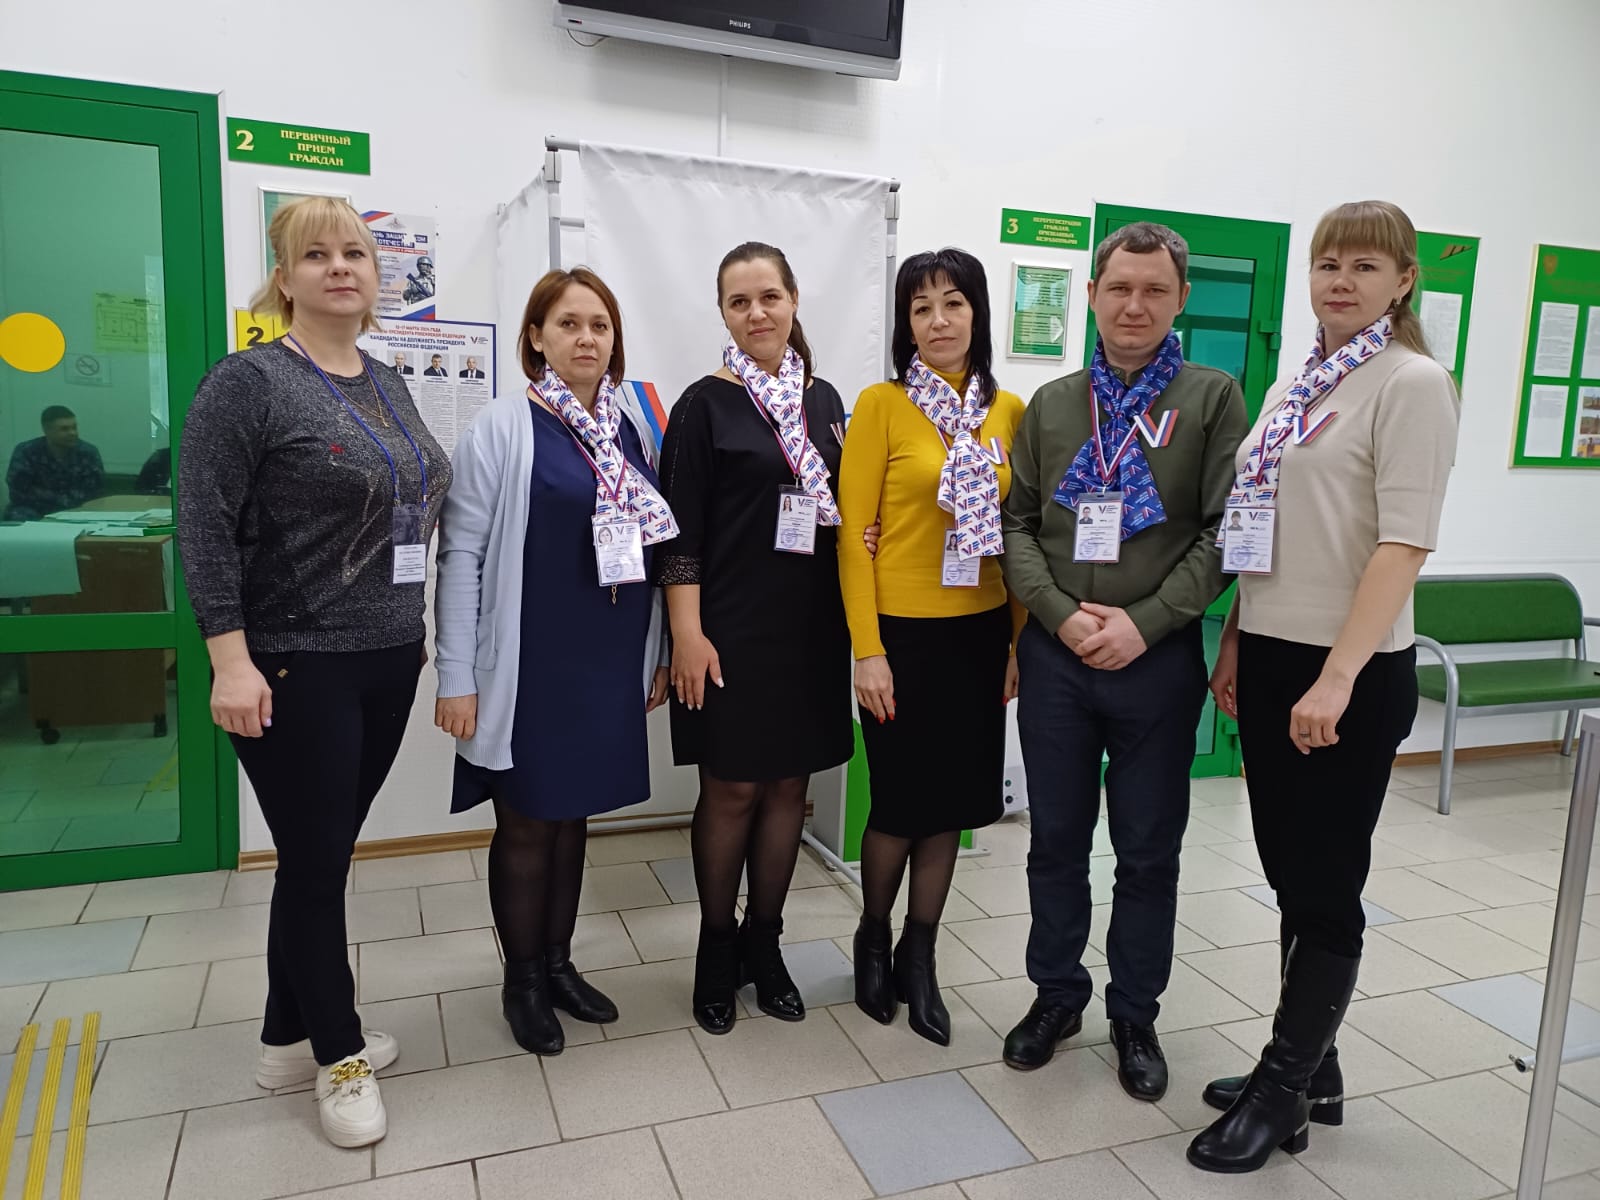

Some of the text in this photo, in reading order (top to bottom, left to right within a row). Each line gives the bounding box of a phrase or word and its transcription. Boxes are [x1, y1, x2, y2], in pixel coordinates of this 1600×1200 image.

[729, 19, 751, 29] PHILIPS
[236, 129, 254, 151] 2
[280, 129, 351, 146] ПЕРВИЧНЫЙ
[297, 142, 335, 155] ПРИЕМ
[289, 152, 344, 167] ГРАЖДАН
[1007, 217, 1019, 234] 3
[246, 326, 265, 347] 2
